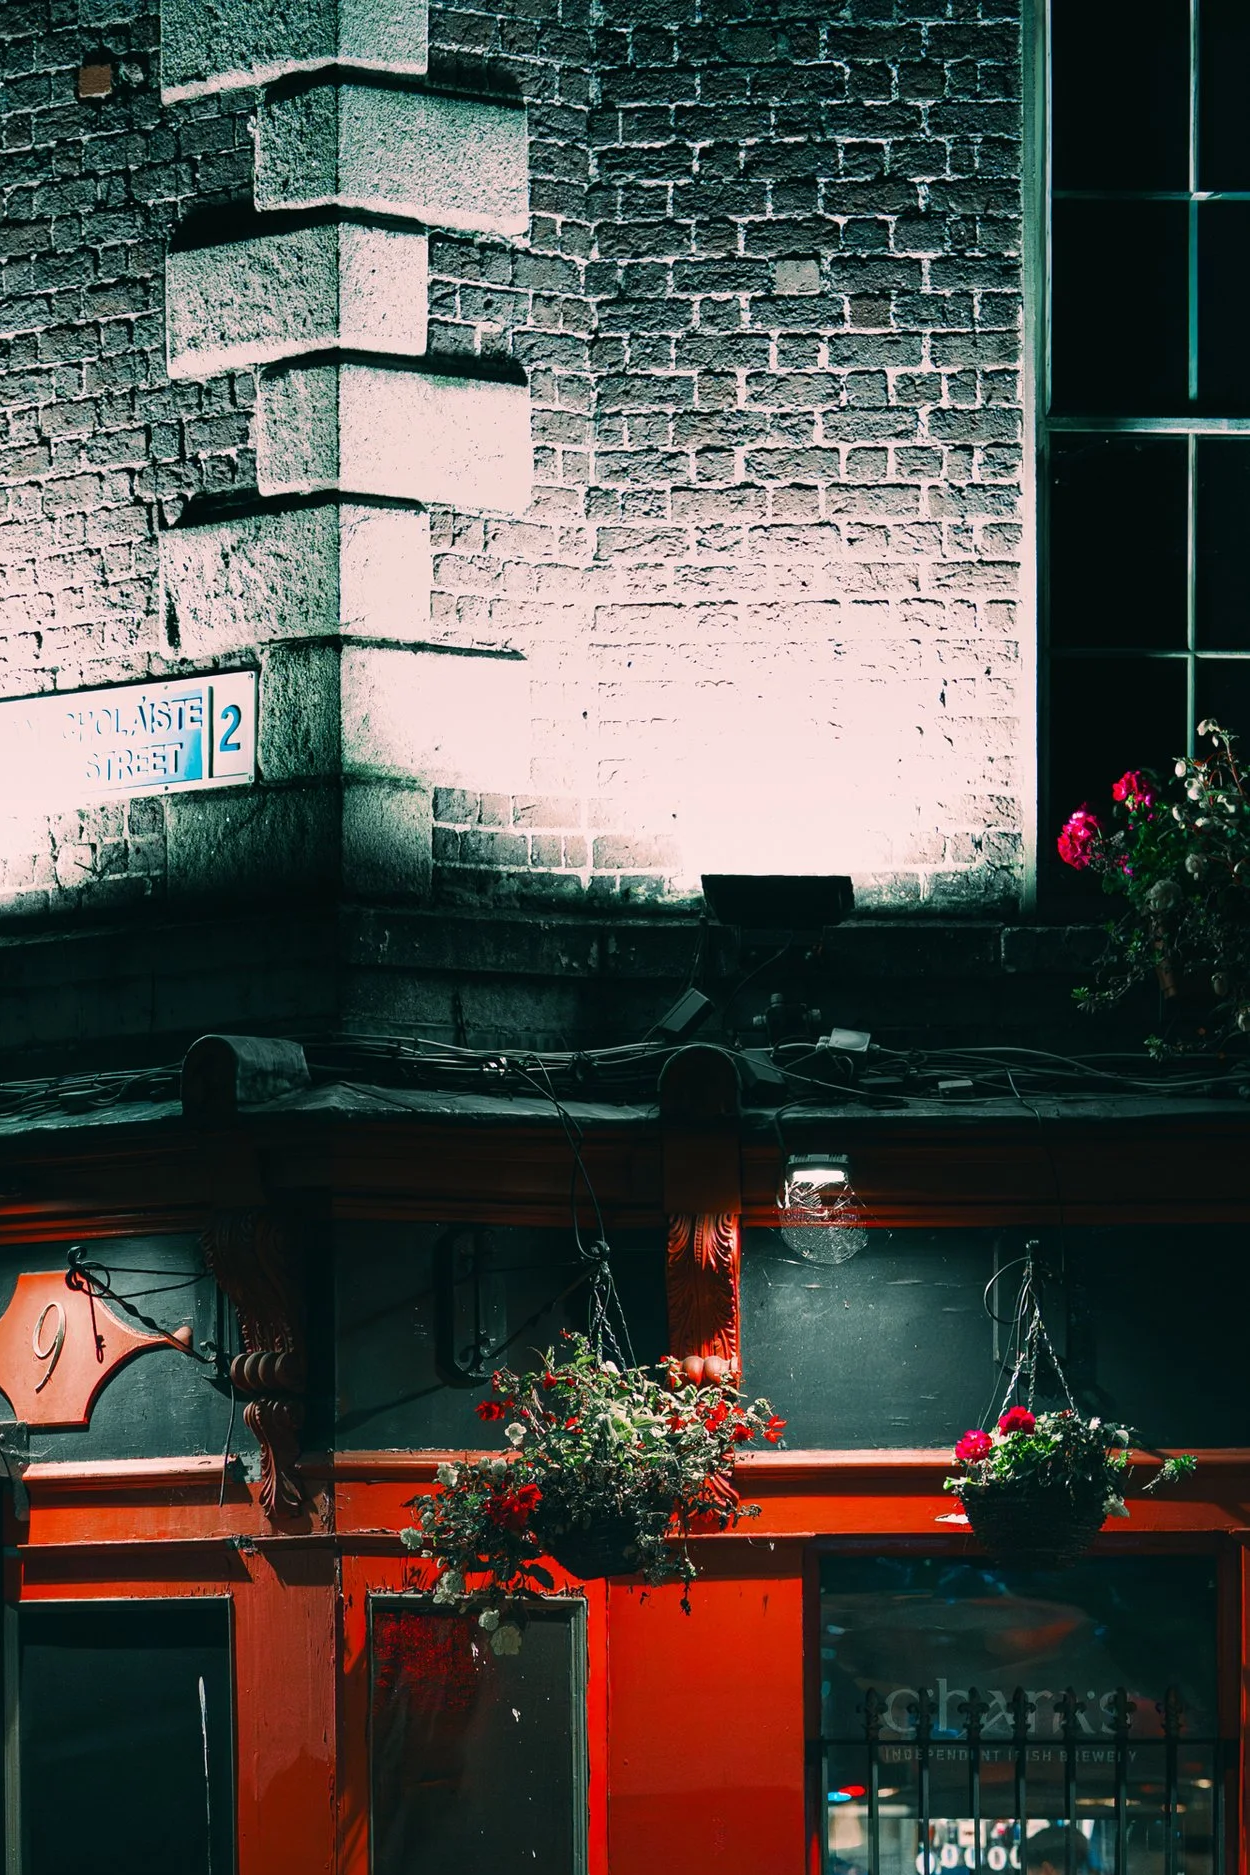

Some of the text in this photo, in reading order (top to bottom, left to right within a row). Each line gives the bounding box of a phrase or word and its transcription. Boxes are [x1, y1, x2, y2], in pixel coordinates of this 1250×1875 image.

[219, 704, 242, 752] 2
[86, 742, 183, 782] STREET
[33, 1302, 66, 1394] 9
[885, 1748, 1137, 1762] INDEENDNT IISH BEWEY
